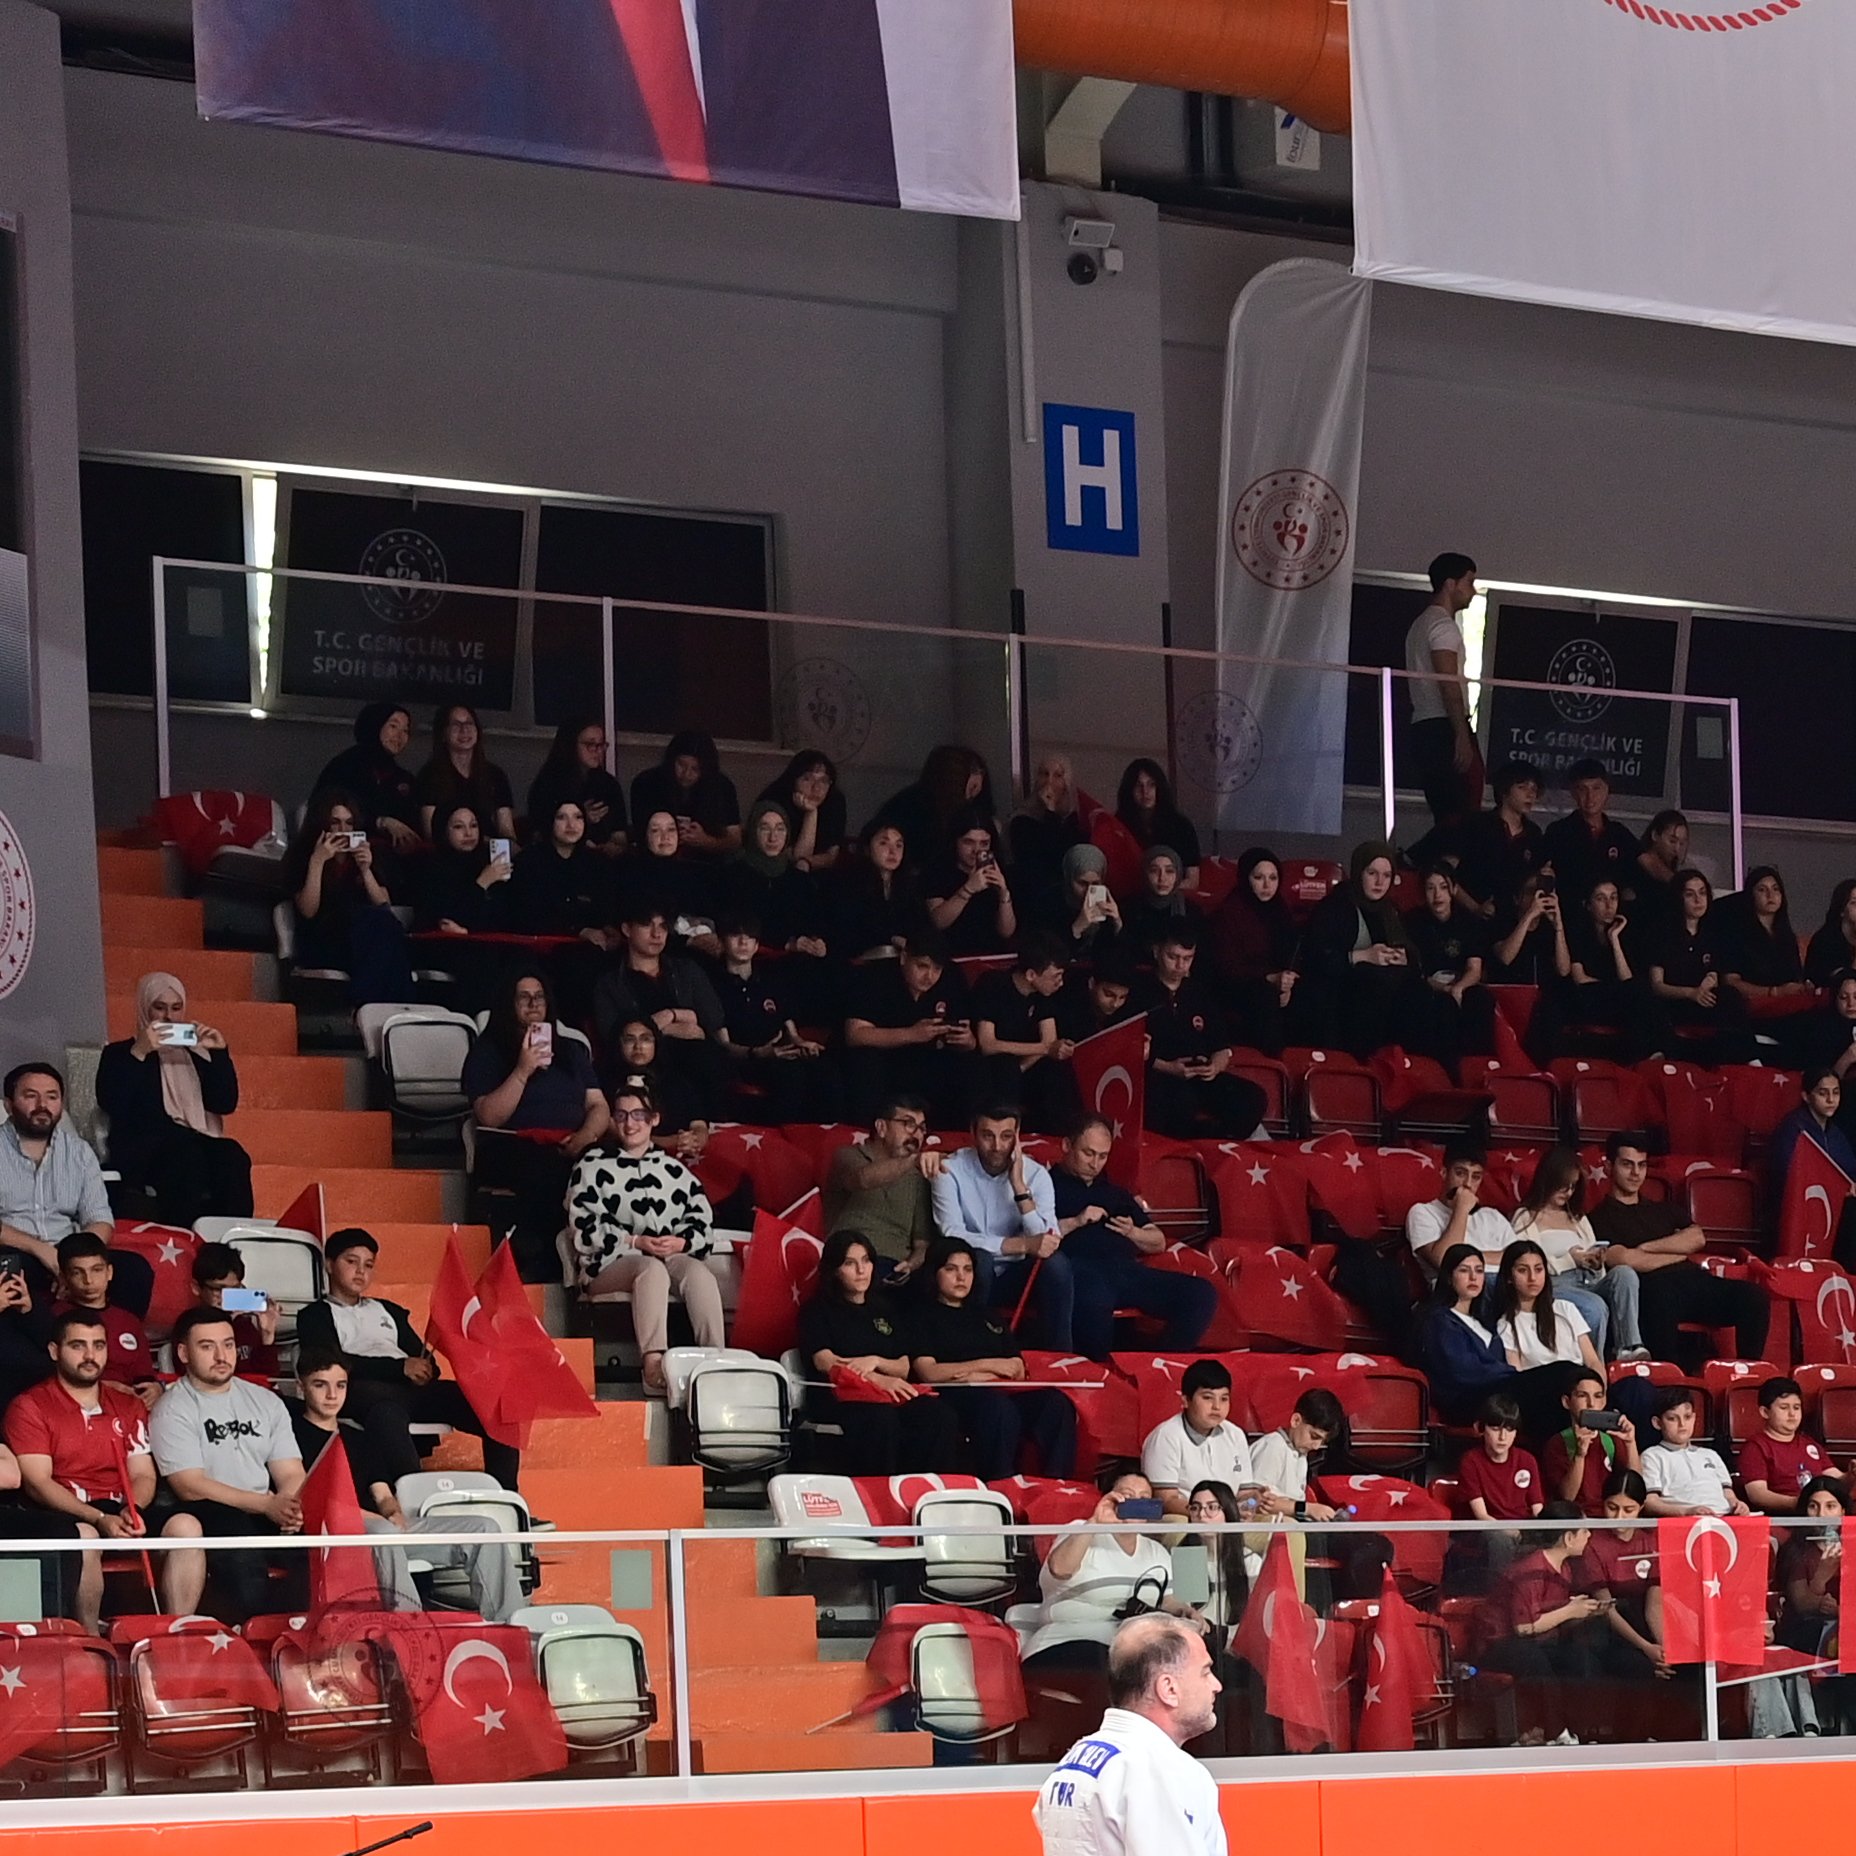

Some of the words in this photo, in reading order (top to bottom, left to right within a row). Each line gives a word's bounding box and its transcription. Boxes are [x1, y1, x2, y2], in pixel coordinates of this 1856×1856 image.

[1062, 424, 1122, 531] H
[459, 641, 485, 660] VE
[1621, 737, 1644, 754] VE
